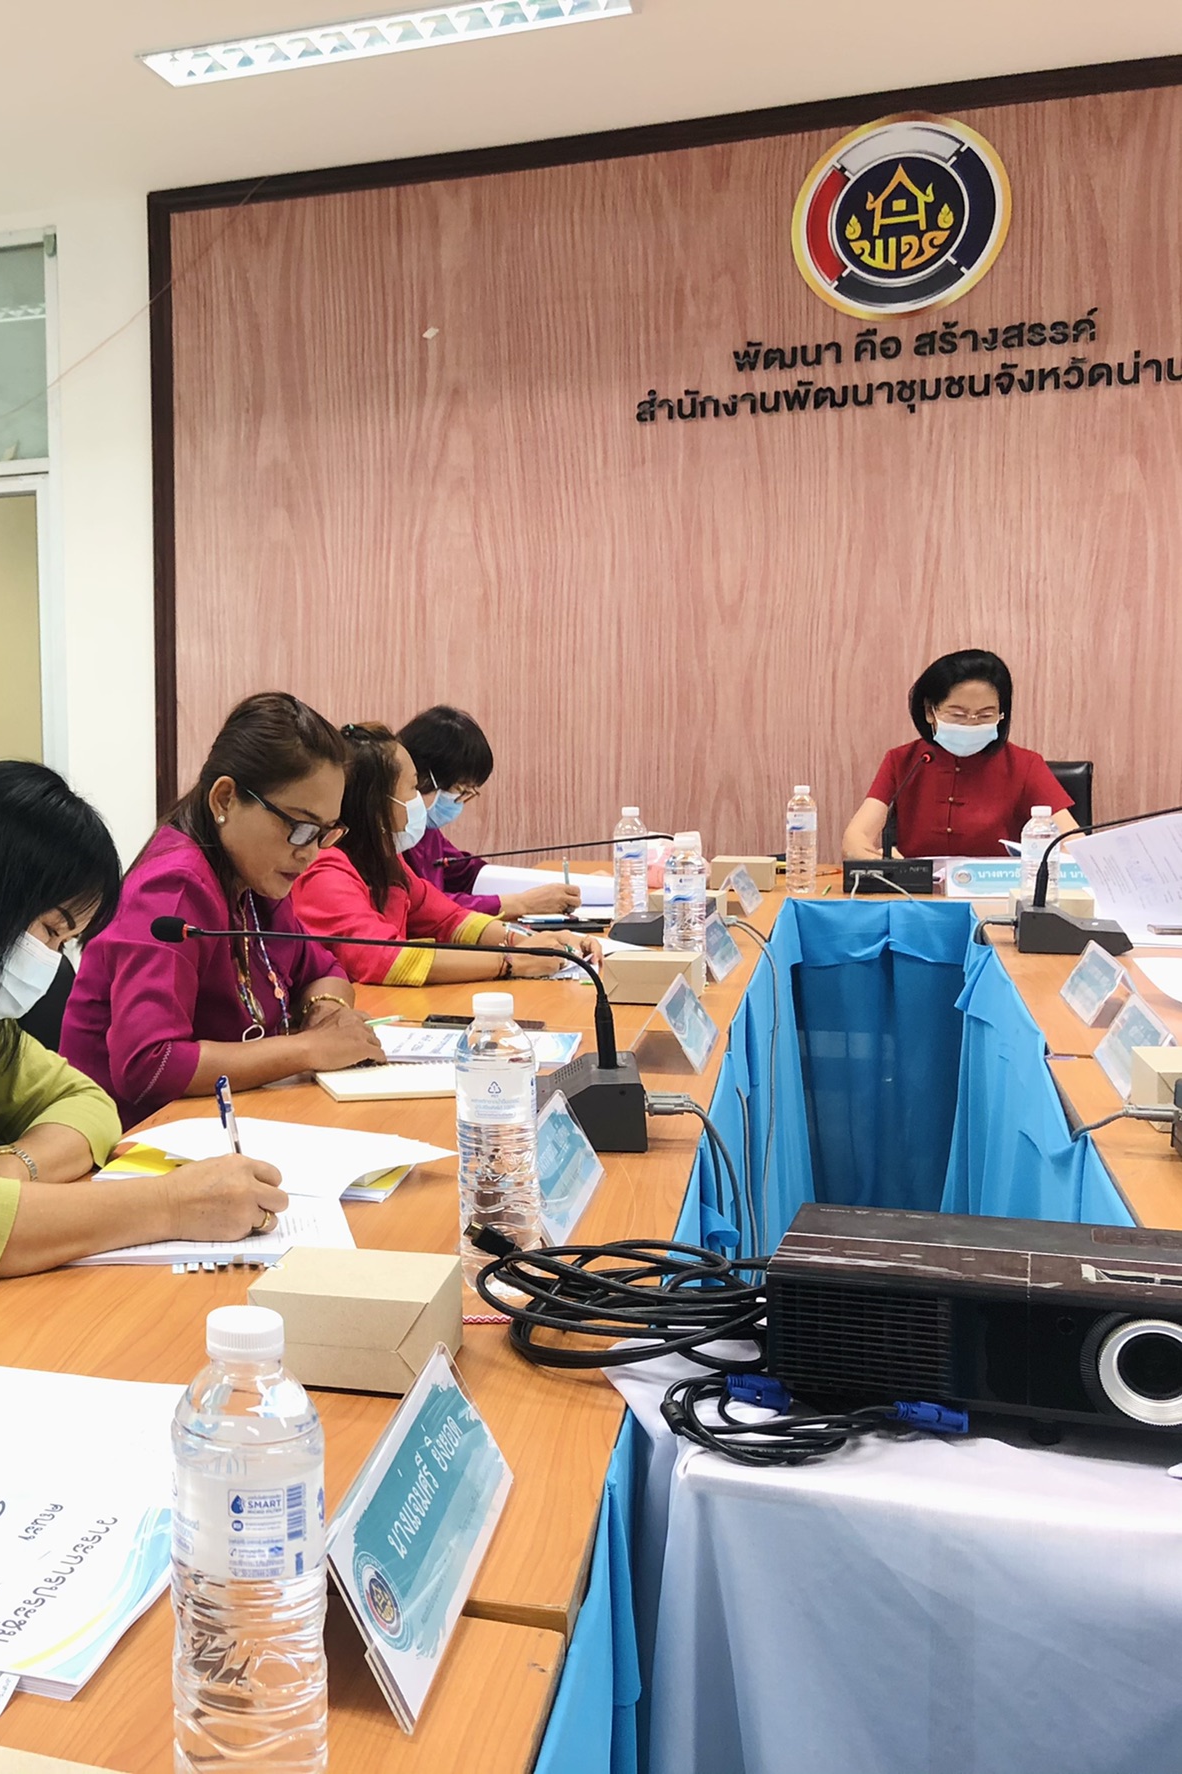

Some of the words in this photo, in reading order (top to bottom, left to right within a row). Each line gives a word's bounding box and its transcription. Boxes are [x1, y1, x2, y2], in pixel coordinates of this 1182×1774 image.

[733, 341, 842, 373] พัฒนา
[854, 327, 902, 363] คือ
[913, 307, 1099, 359] สร้างสรรค์
[248, 1500, 281, 1509] SMART
[387, 1451, 439, 1559] นางแจ่มศรี
[421, 1415, 463, 1472] ยิ่งยอด
